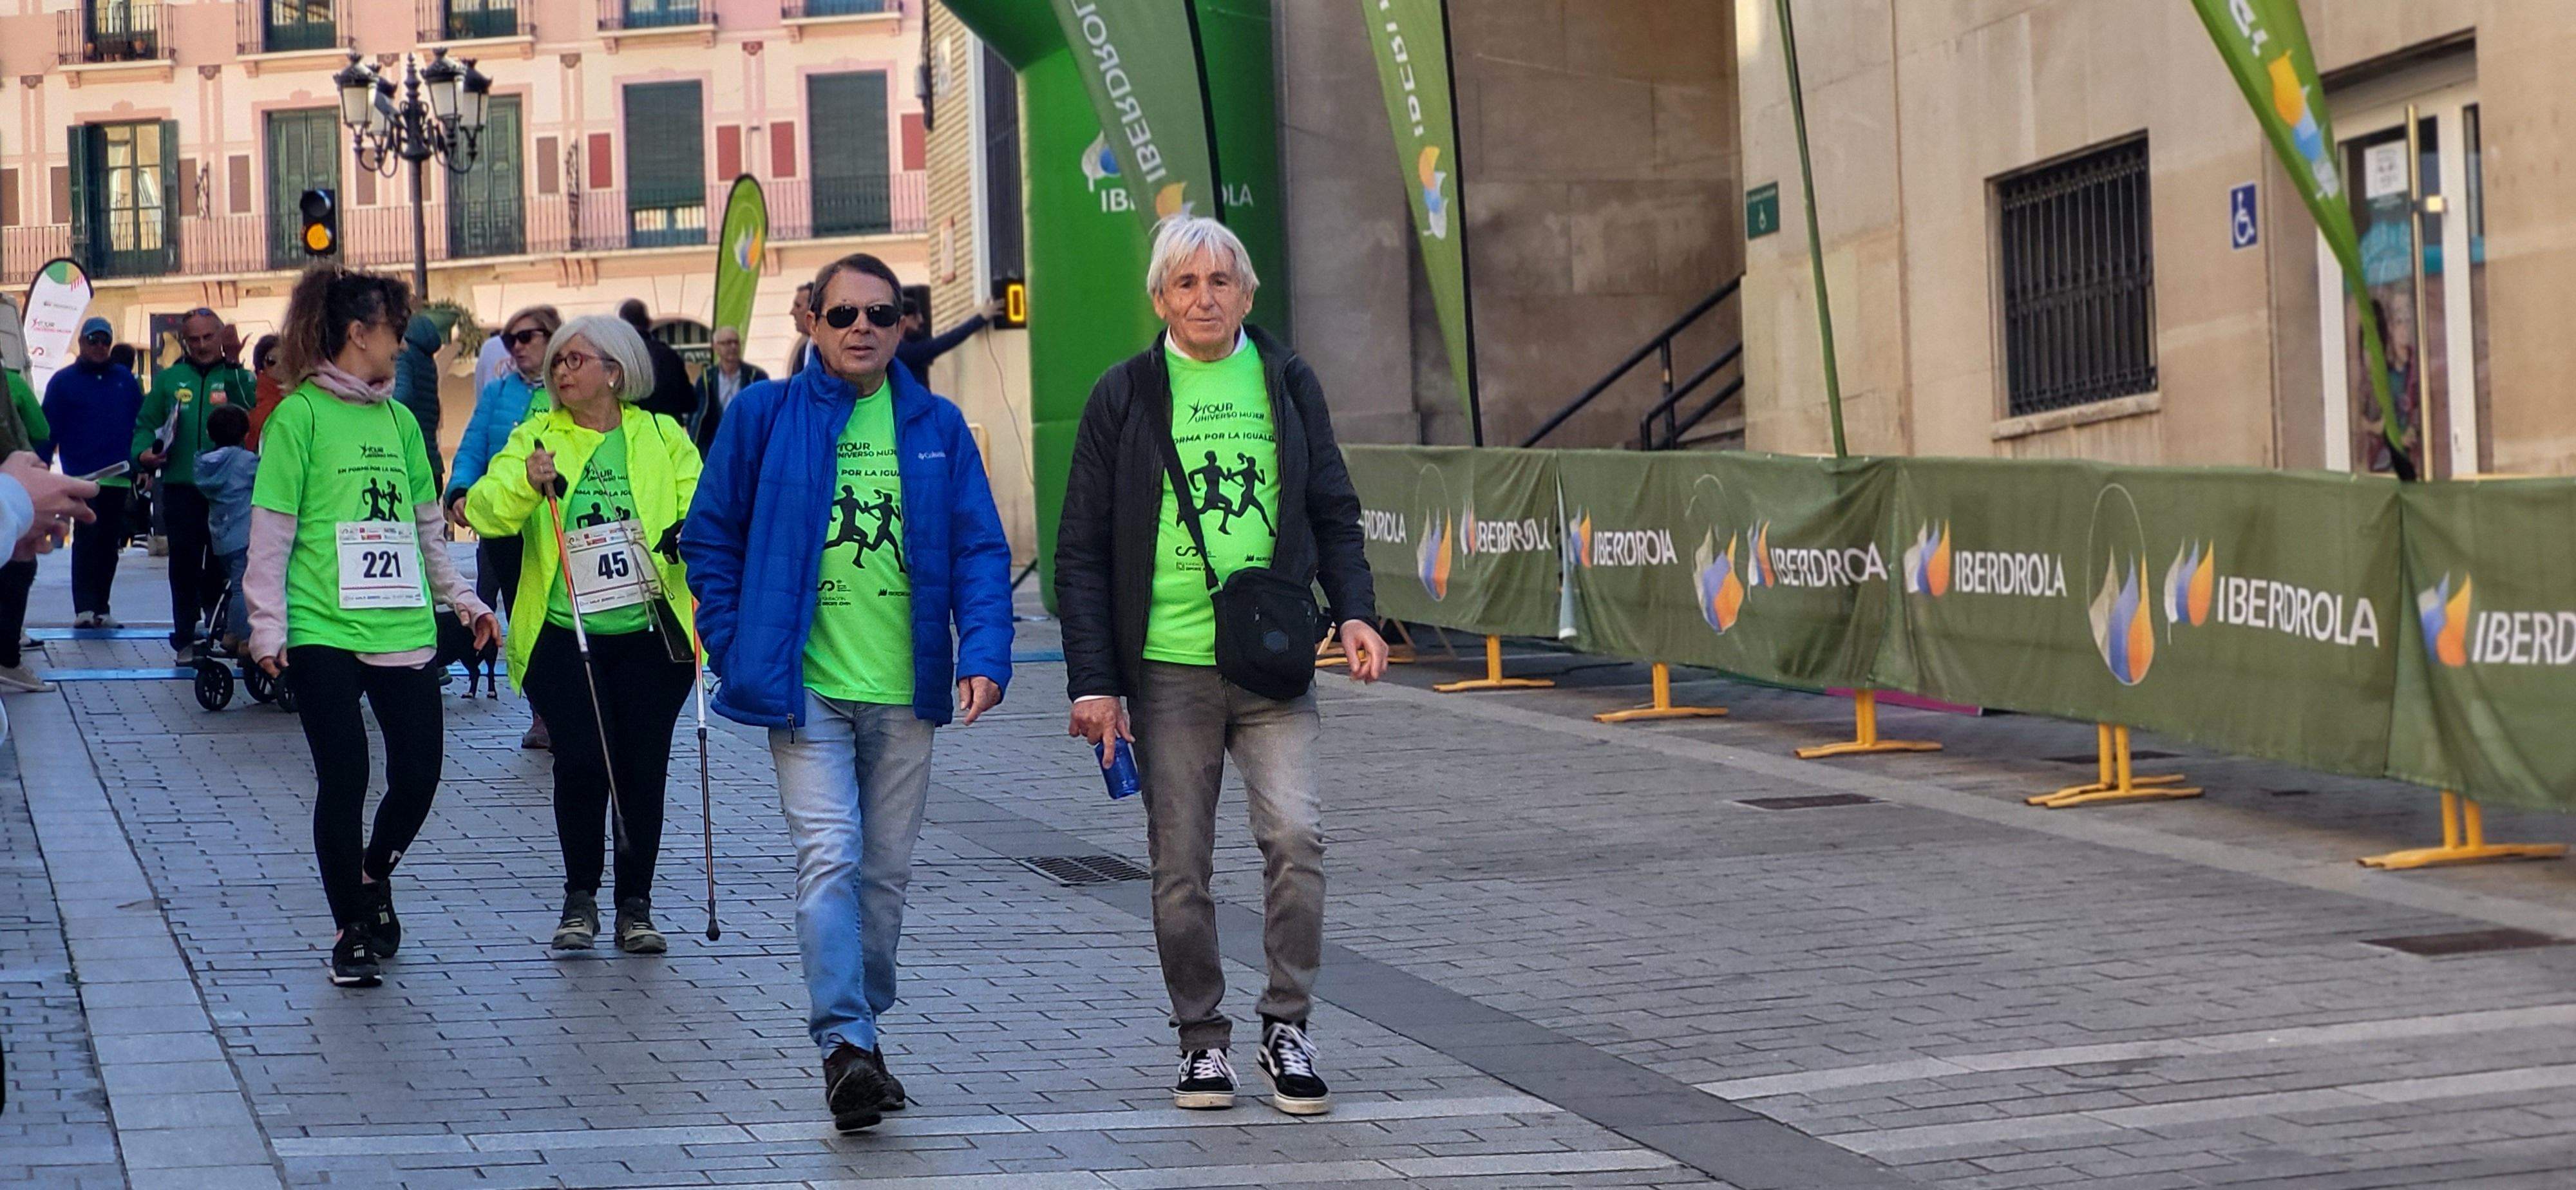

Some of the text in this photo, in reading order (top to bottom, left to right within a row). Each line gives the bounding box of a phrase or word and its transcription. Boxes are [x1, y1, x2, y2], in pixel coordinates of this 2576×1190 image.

[1195, 411, 1237, 423] UNIVERSO
[1173, 433, 1201, 444] ORMA
[1227, 431, 1240, 440] LA
[1243, 432, 1276, 442] IGUALD
[838, 450, 875, 458] NIVERSO
[1357, 509, 1408, 544] RDROLA
[363, 550, 402, 578] 221
[597, 550, 630, 580] 45
[1955, 550, 2068, 598] IBERDROLA
[2217, 576, 2380, 649] IBERDROLA
[2472, 610, 2576, 666] IBERD
